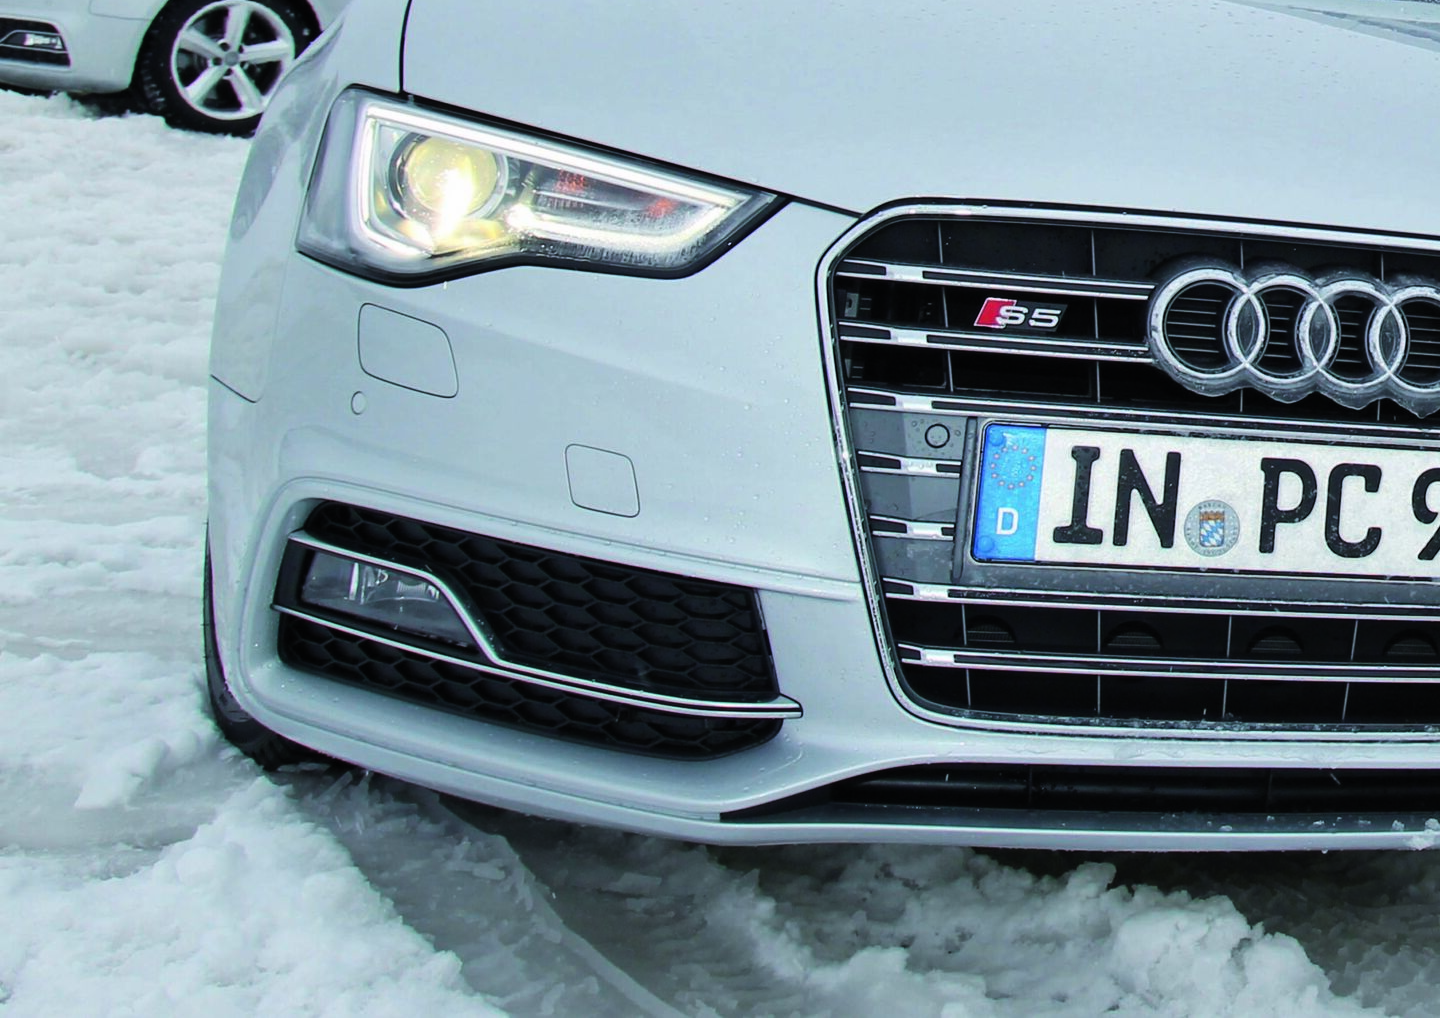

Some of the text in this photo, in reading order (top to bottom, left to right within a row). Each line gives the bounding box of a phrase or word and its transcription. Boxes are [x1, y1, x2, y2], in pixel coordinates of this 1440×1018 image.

[995, 304, 1062, 328] S5
[1052, 446, 1182, 548] IN
[1258, 457, 1383, 559] PC
[996, 507, 1019, 535] D
